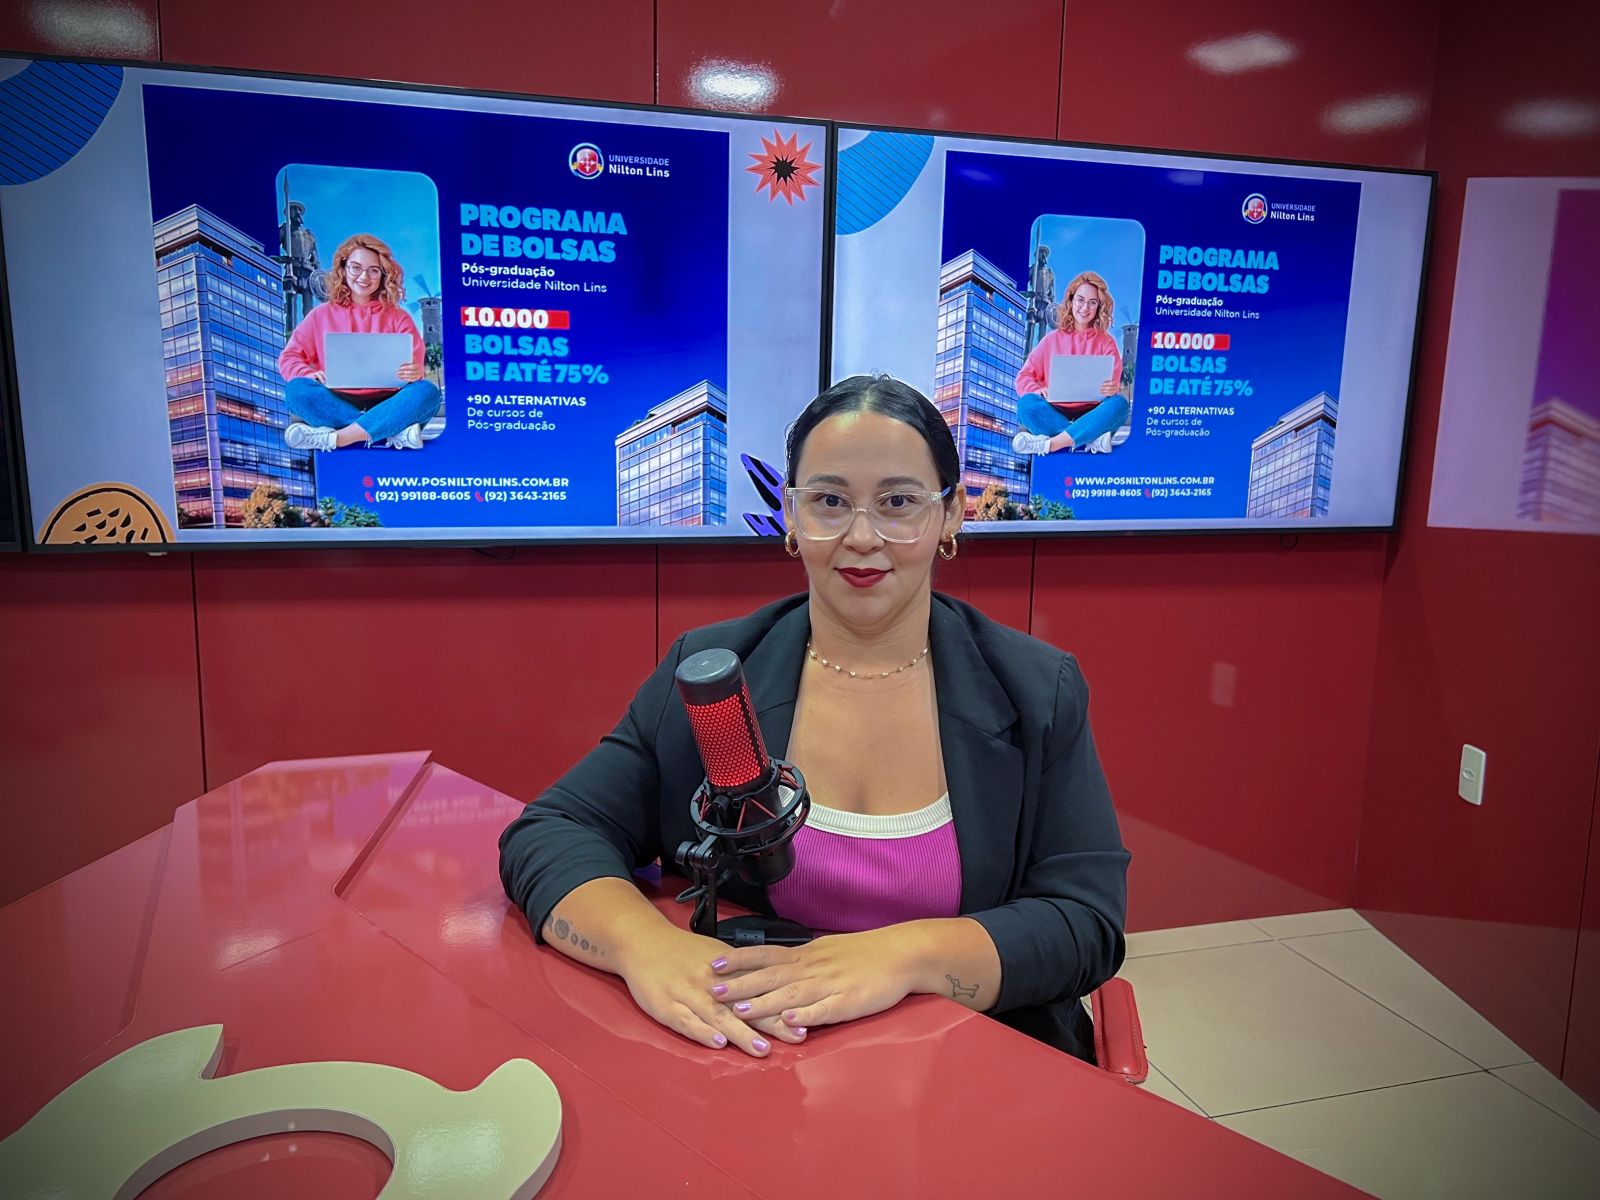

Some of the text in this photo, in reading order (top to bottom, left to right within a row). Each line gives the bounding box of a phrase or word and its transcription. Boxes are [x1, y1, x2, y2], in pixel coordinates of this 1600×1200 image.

[608, 154, 670, 166] UNIVERSIDADE
[608, 164, 670, 178] Nilton Lins
[1271, 202, 1316, 212] UNIVERSIDADE
[460, 202, 628, 235] PROGRAMA
[1270, 210, 1315, 222] Nilton Lins
[461, 232, 616, 263] DE BOLSAS
[1159, 245, 1279, 271] PROGRAMA
[461, 262, 555, 278] Pós-graduação
[462, 276, 607, 293] Universidade Nilton Lins
[1157, 269, 1269, 294] DE BOLSAS
[1155, 294, 1223, 307] Pós-graduação
[464, 306, 549, 329] 10.000
[1155, 306, 1260, 320] Universidade Nilton Lins
[464, 333, 569, 357] BOLSAS
[1153, 331, 1215, 351] 10.000
[1151, 354, 1227, 374] BOLSAS
[465, 358, 610, 385] DE ATÉ 75%
[1149, 375, 1254, 397] DE ATÉ 75%
[466, 394, 587, 407] +90 ALTERNATIVAS
[467, 407, 544, 418] De cursos de
[1147, 406, 1235, 416] +90 ALTERNATIVAS
[467, 419, 556, 432] Pós-graduação
[1146, 416, 1203, 426] De cursos de
[1145, 427, 1210, 438] Pós-graduação
[377, 476, 569, 487] WWW.POSNILTONLINS.COM.BR
[1074, 476, 1215, 485] WWW.POSNILTONLINS.COM.BR
[375, 490, 567, 503] (92) 99188-8605 (92) 3643-2165
[1071, 488, 1212, 499] (92) 99188-8605 (92) 3643-2165
